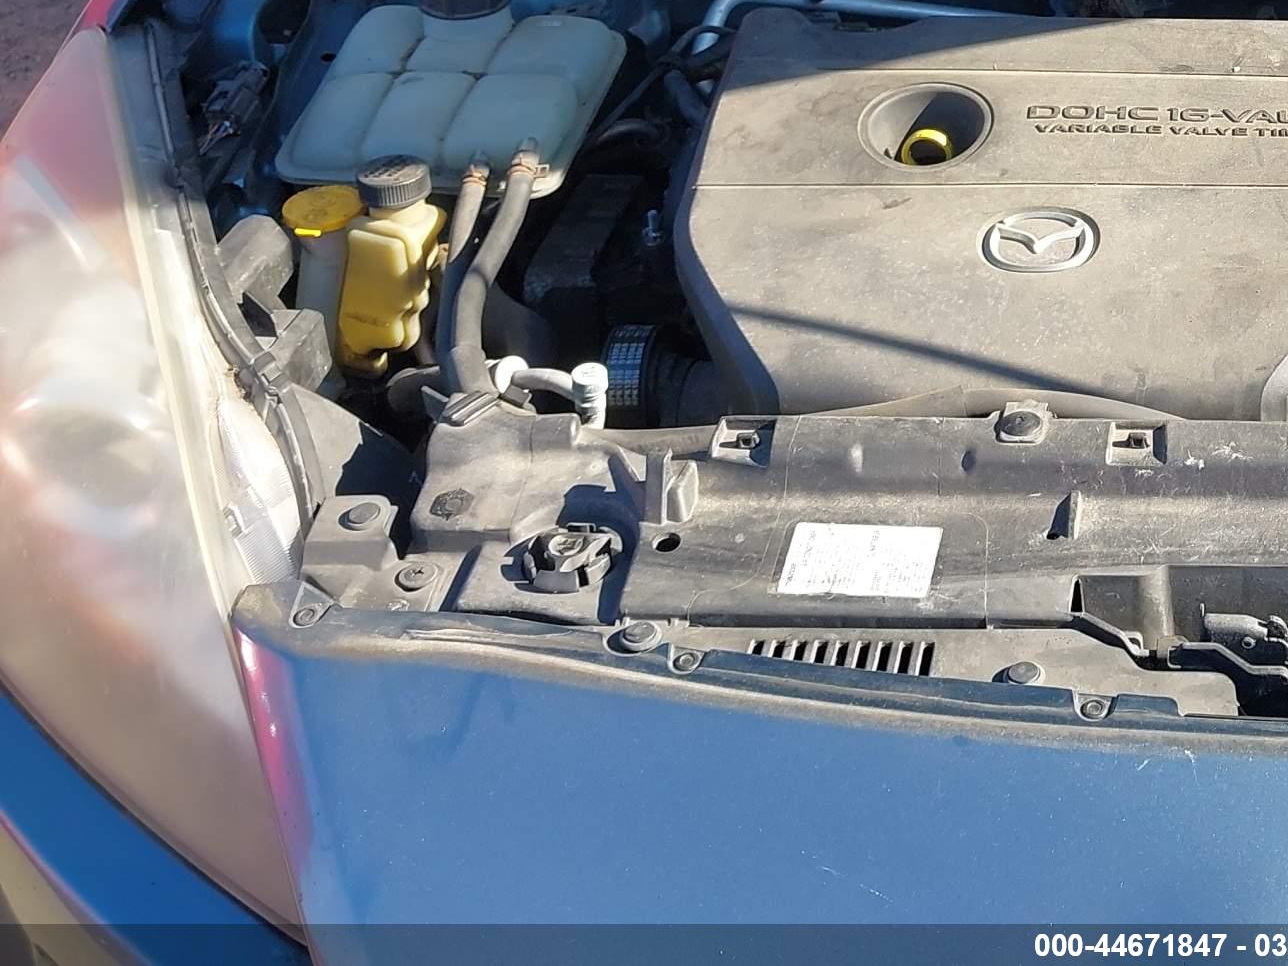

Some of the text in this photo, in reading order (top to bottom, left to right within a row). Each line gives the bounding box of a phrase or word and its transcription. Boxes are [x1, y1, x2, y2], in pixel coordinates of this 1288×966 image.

[1026, 105, 1159, 121] DOHC
[1034, 124, 1163, 135] VARIABLE
[1169, 125, 1249, 136] VALVE
